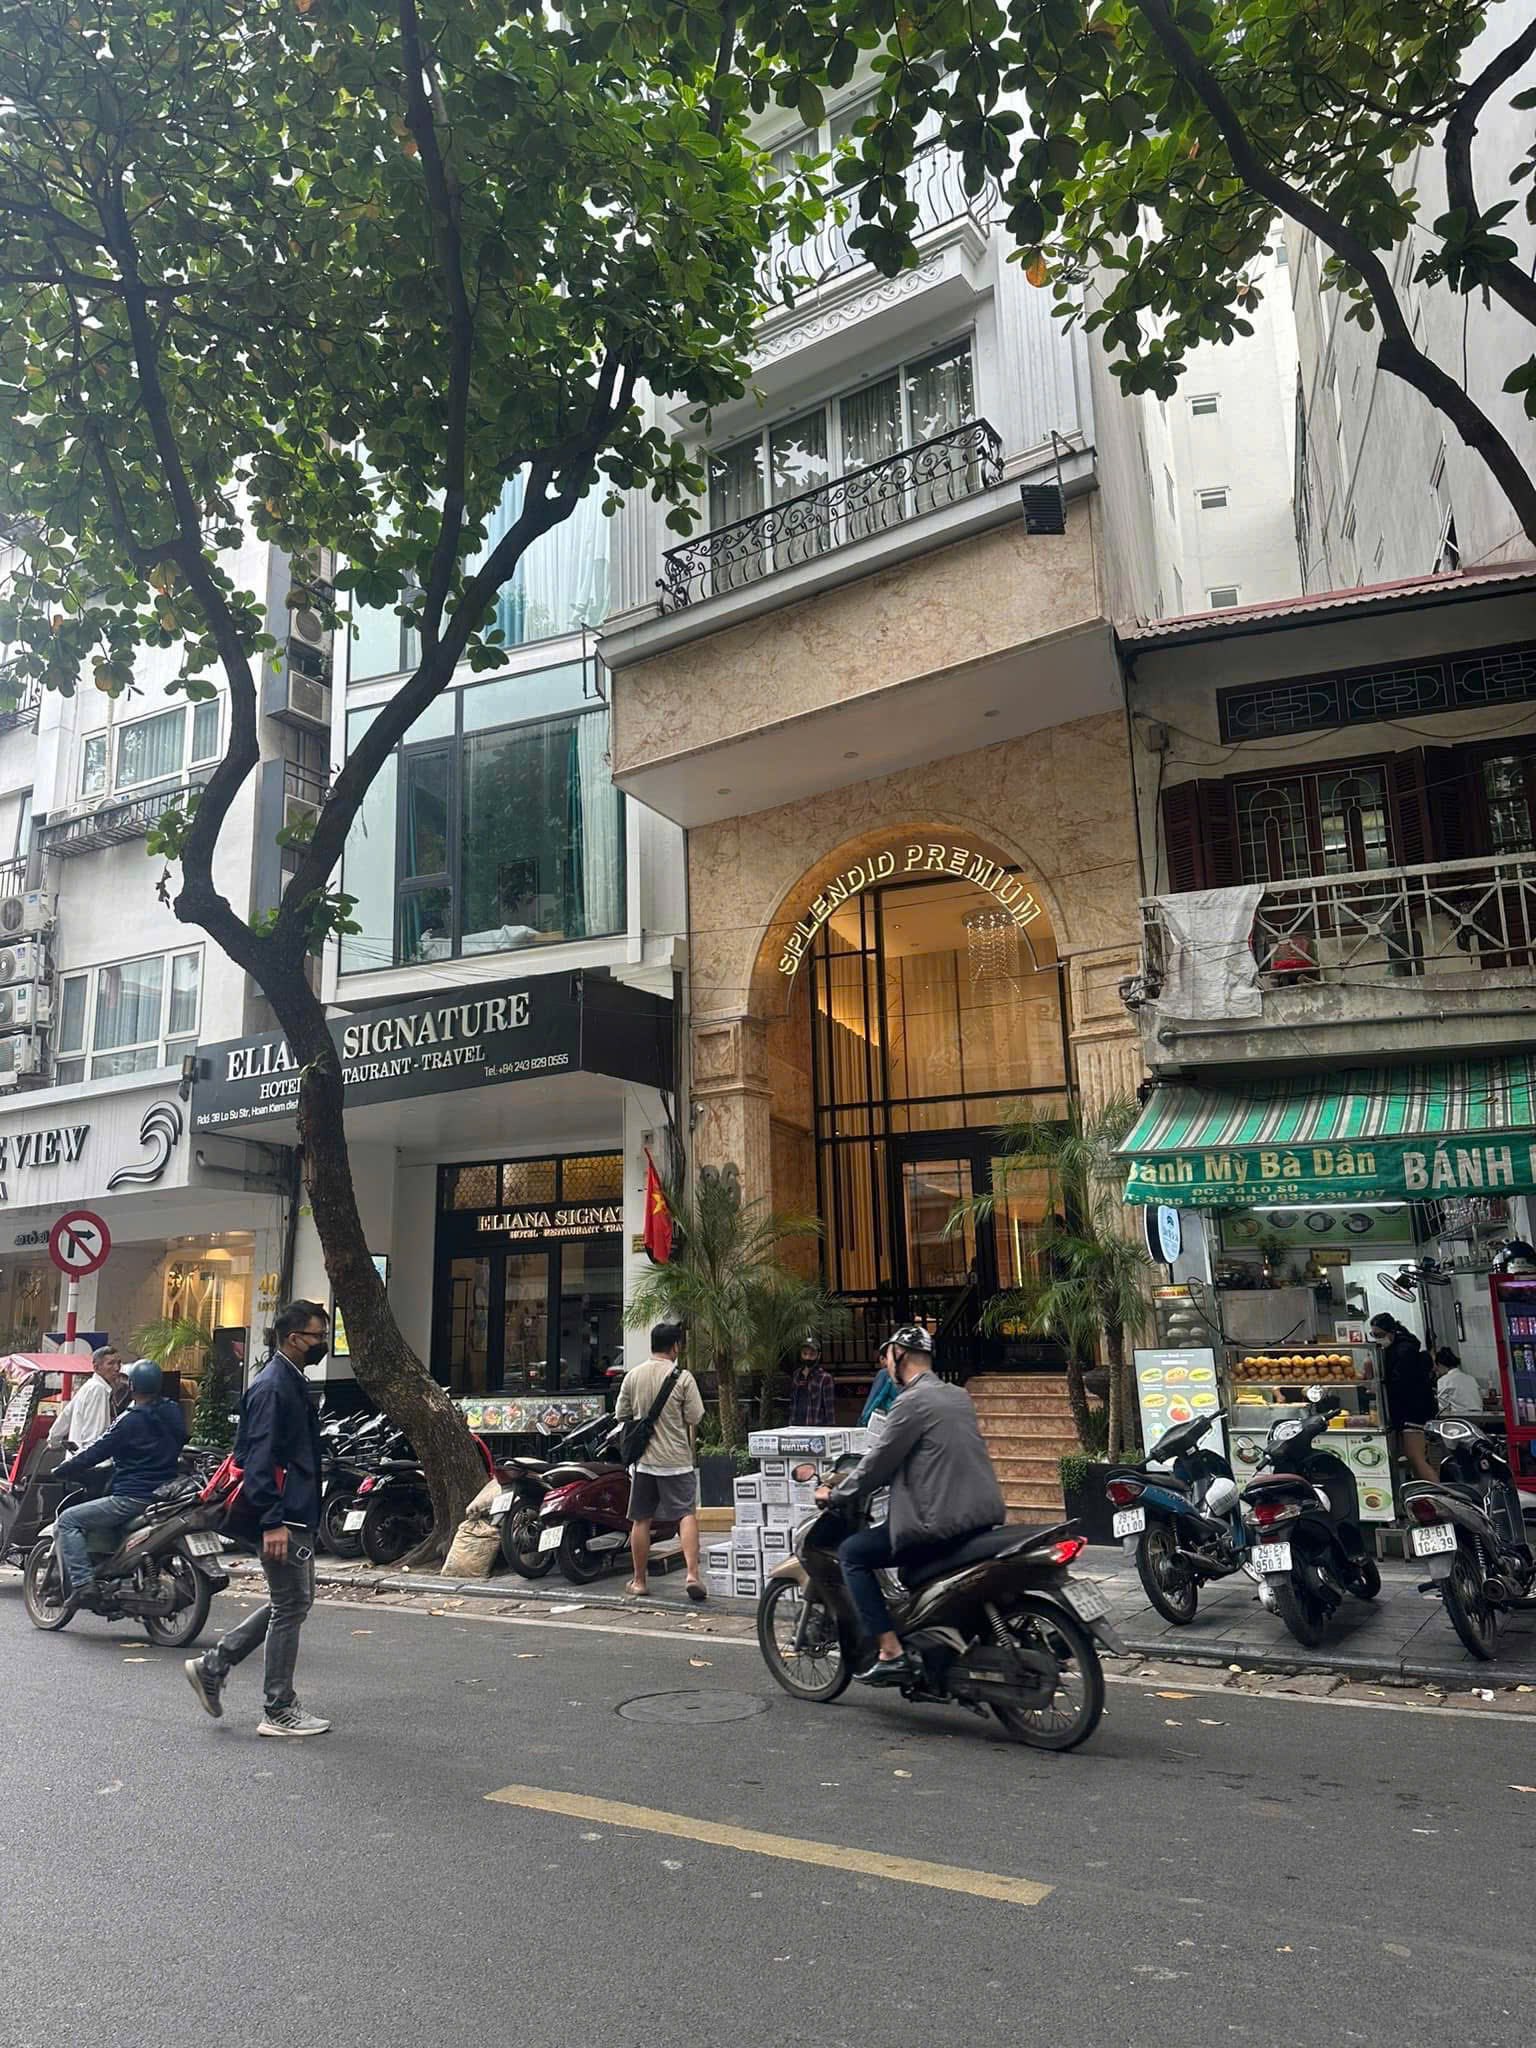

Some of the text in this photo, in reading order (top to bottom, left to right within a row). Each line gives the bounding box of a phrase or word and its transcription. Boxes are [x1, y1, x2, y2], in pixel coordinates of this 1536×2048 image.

[778, 843, 1042, 975] SPLENDID PREMIUM
[226, 992, 530, 1081] ELIA SIGNATURE
[341, 1057, 411, 1085] TAURANT
[421, 1045, 485, 1070] TRAVEL
[514, 1060, 530, 1072] 243
[531, 1056, 547, 1069] 829
[548, 1053, 569, 1067] 0555
[1260, 1150, 1301, 1178] Bà
[1402, 1139, 1515, 1190] BÁNH
[476, 1210, 551, 1232] ELIANA
